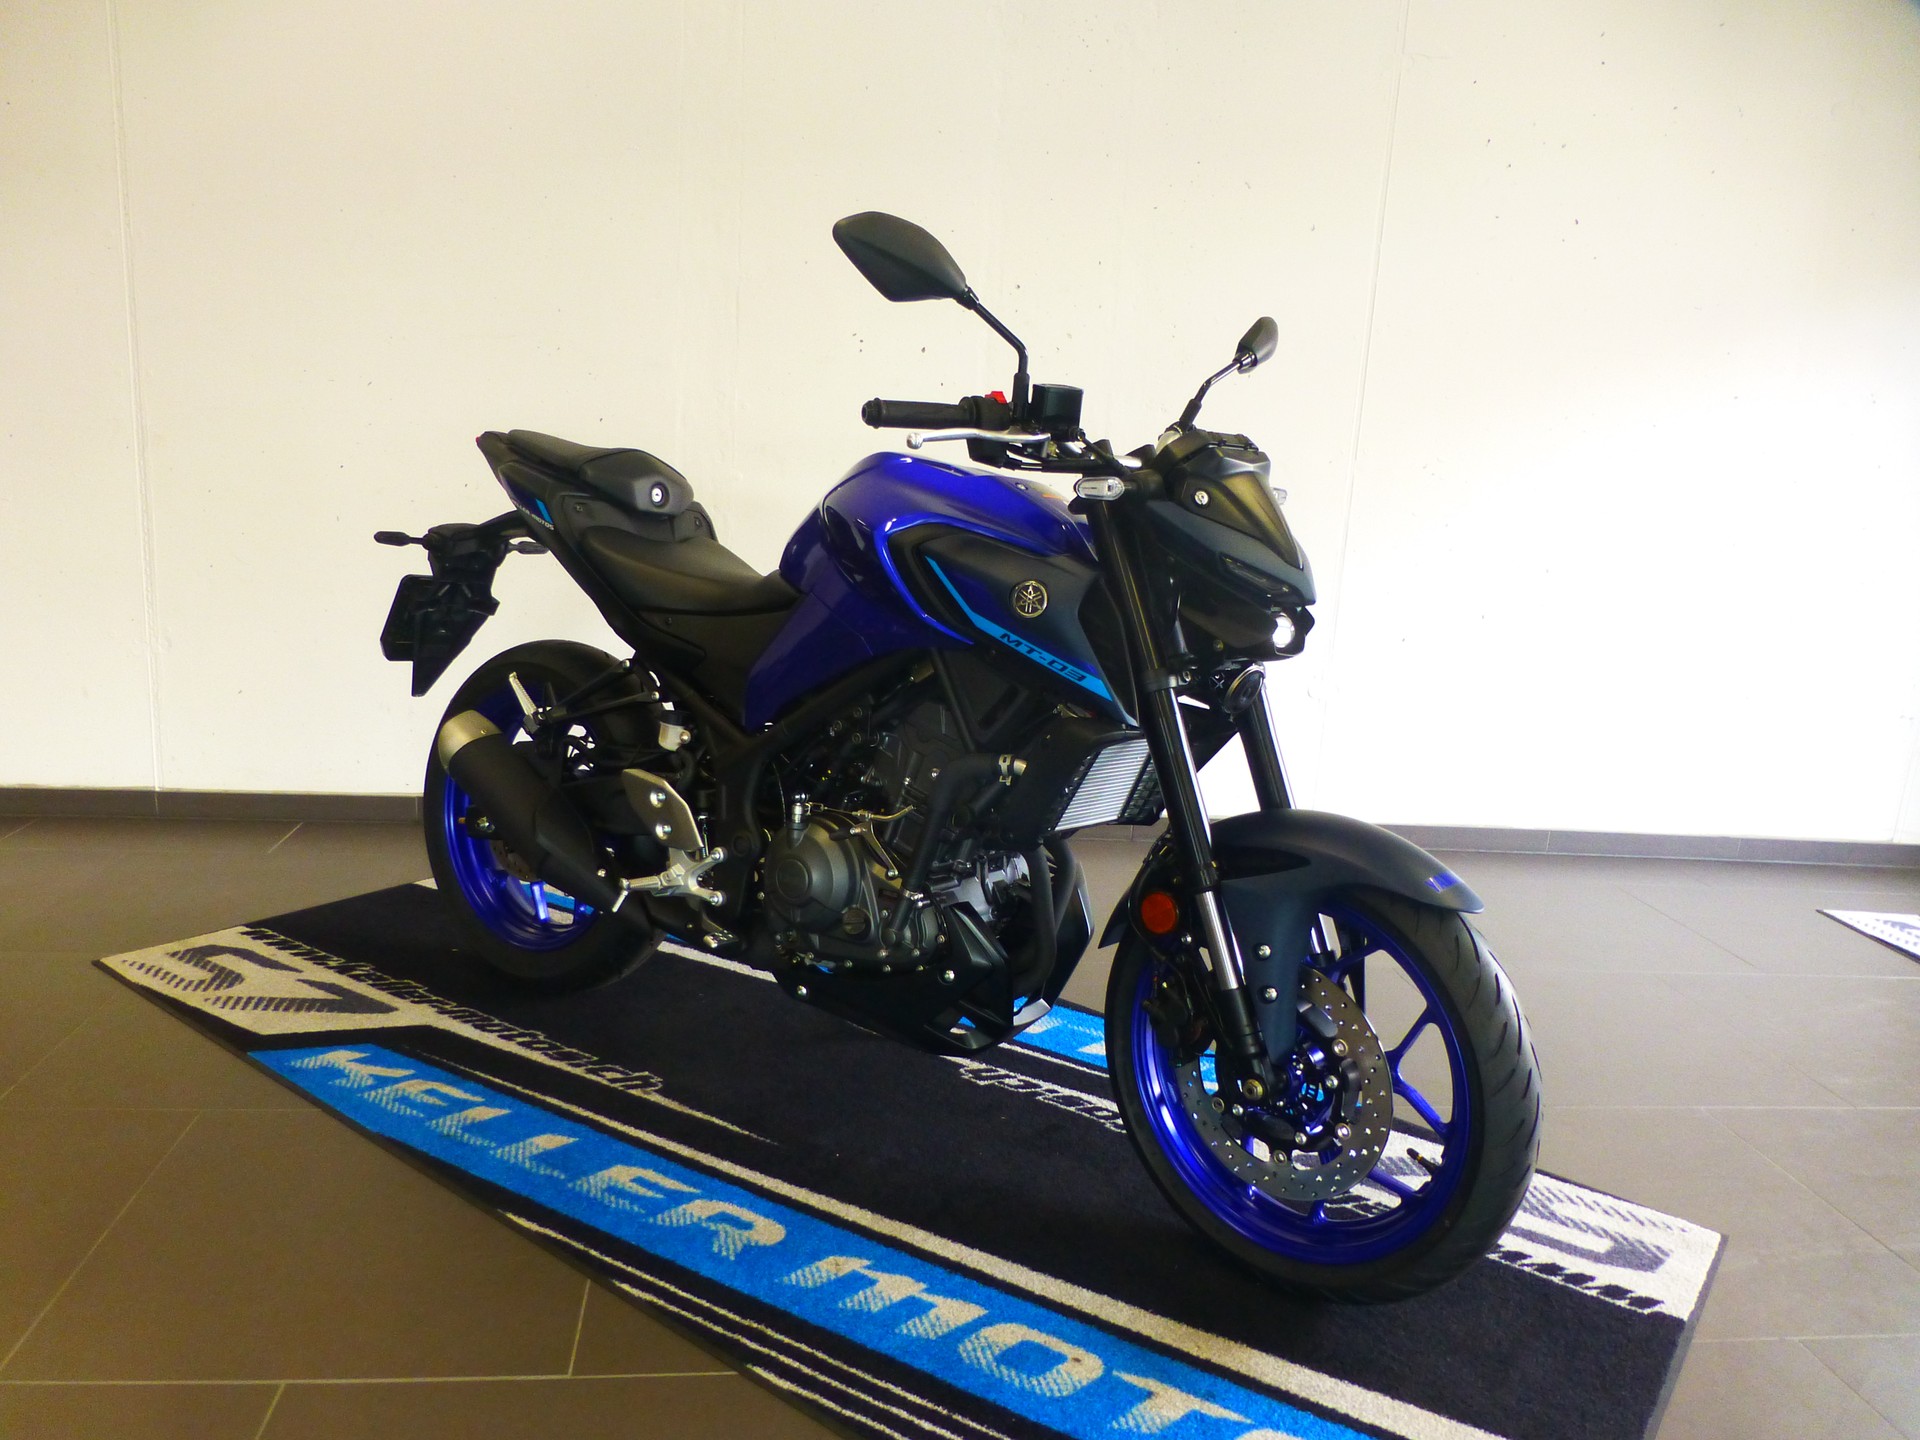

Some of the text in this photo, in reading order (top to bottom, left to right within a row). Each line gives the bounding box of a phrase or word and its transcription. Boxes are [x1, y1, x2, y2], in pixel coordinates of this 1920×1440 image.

[1000, 632, 1087, 682] MT-03
[289, 1049, 788, 1262] KELLER
[777, 1255, 1307, 1440] MOT
